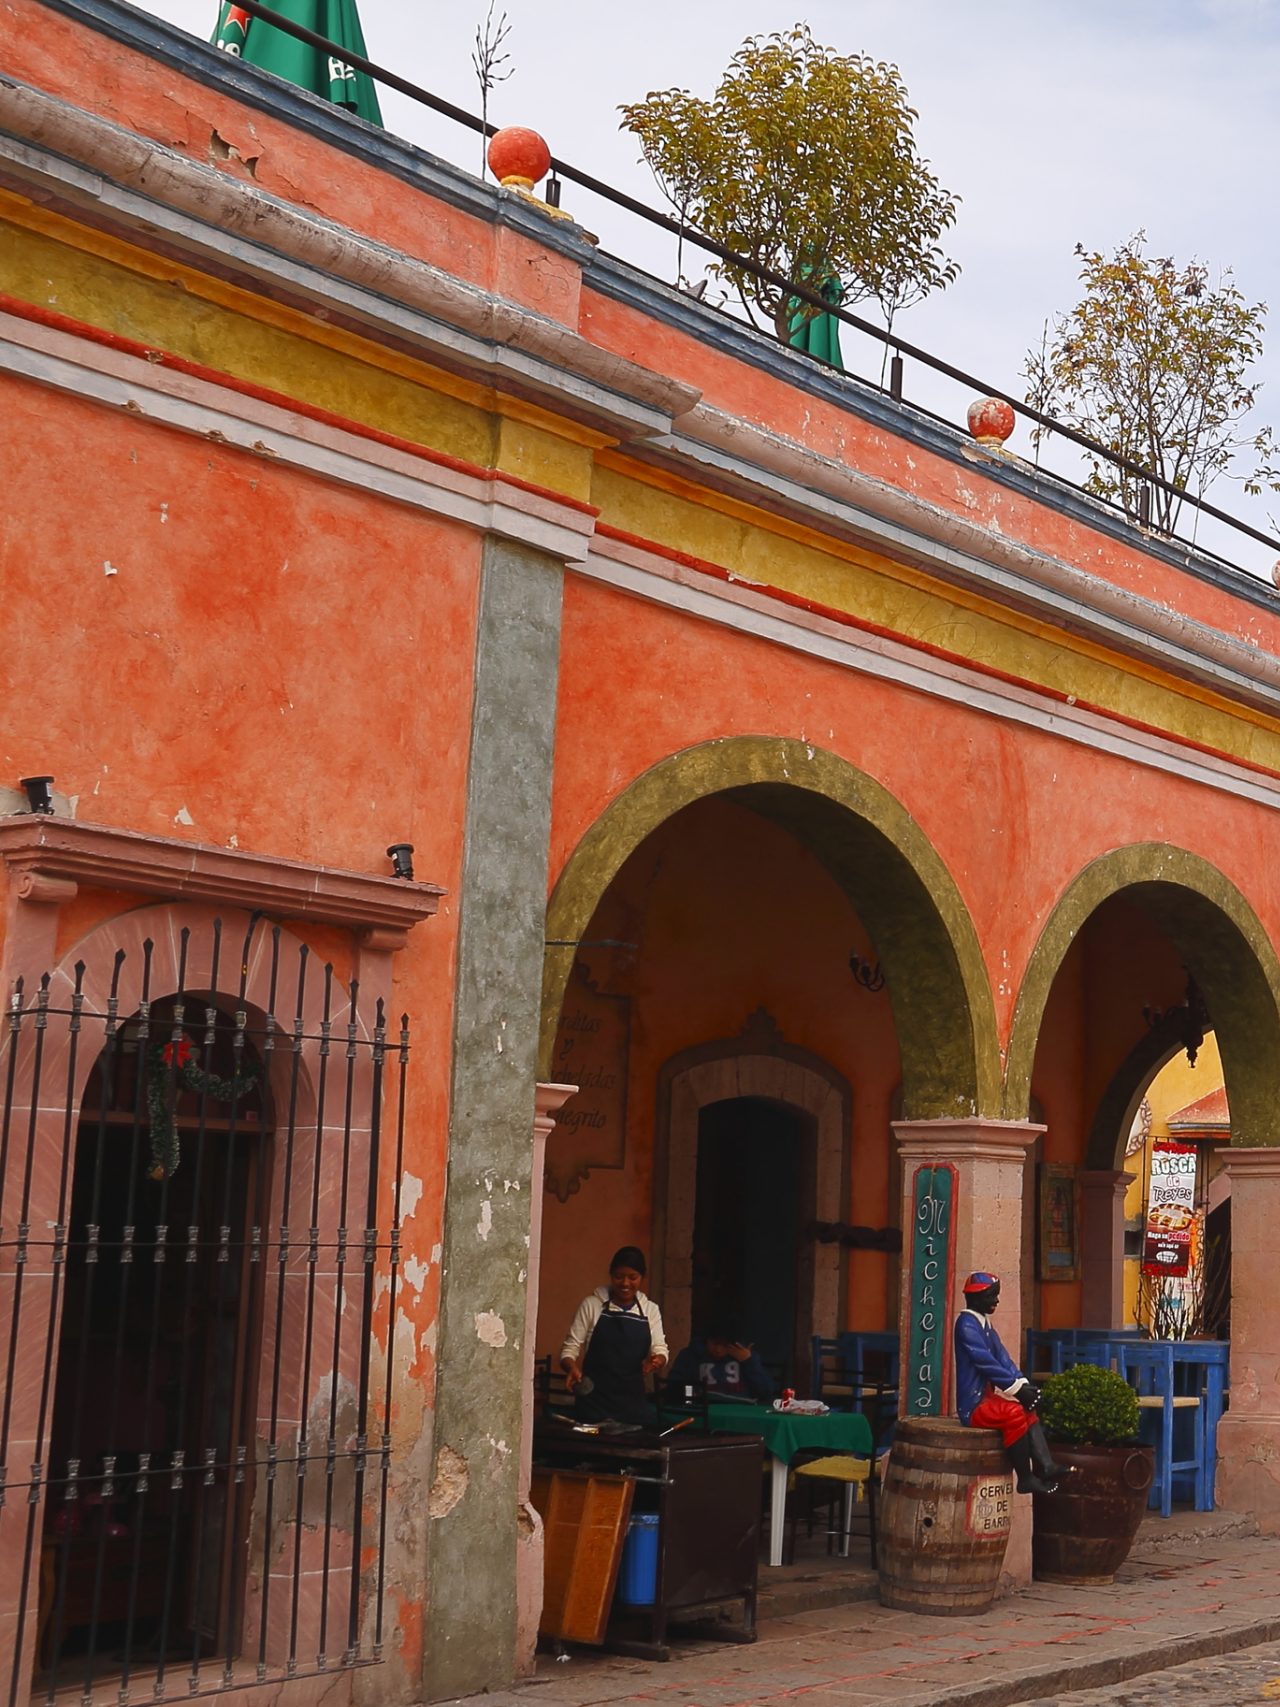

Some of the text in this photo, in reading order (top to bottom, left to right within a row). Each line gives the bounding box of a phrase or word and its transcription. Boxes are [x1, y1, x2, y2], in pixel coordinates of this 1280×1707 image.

[1153, 1186, 1192, 1202] Reyes
[915, 1195, 946, 1416] Michelad
[724, 1361, 740, 1384] 9
[980, 1483, 1013, 1499] CERVE
[996, 1500, 1008, 1513] DE
